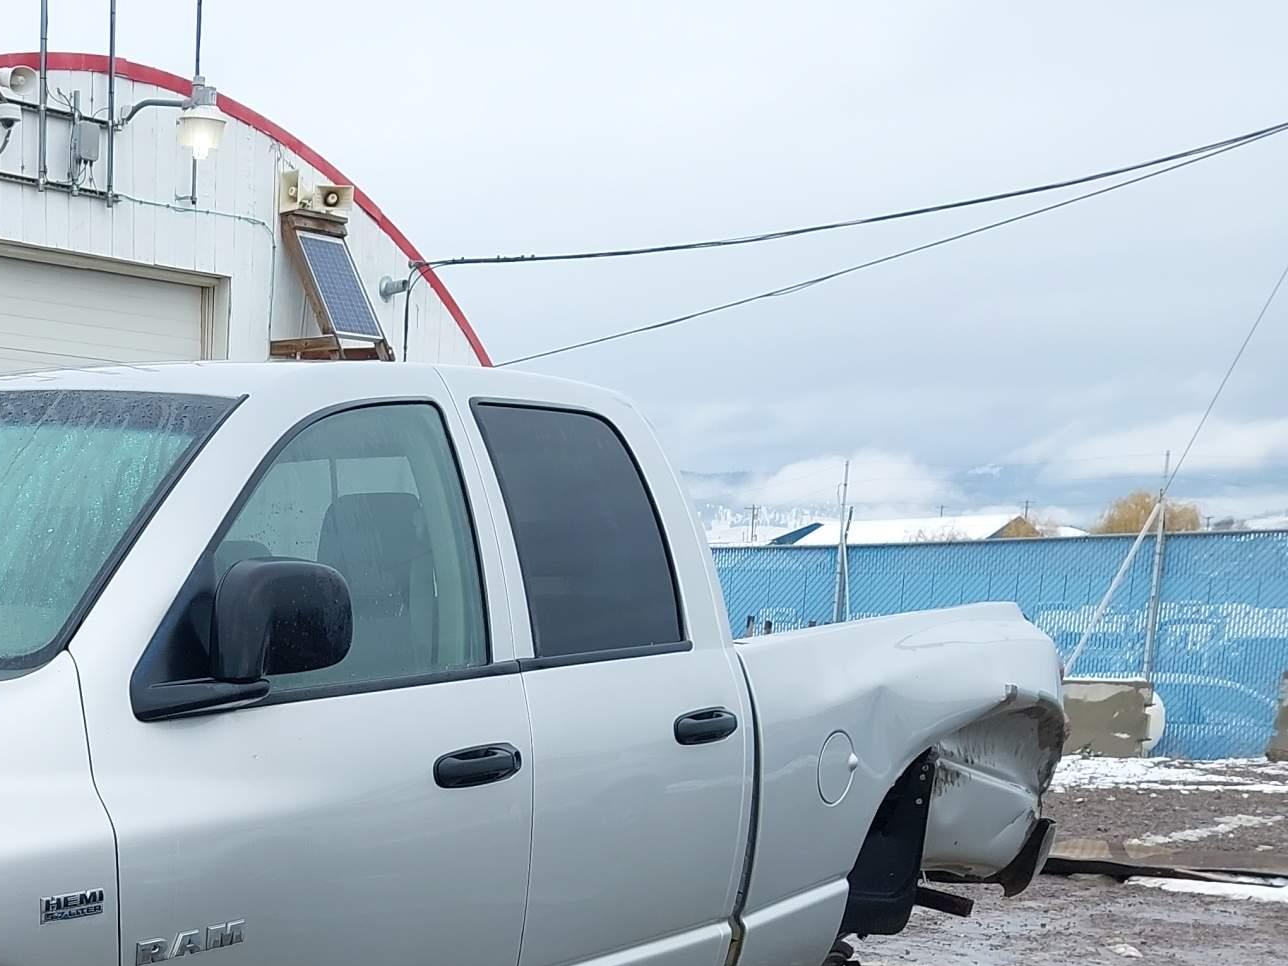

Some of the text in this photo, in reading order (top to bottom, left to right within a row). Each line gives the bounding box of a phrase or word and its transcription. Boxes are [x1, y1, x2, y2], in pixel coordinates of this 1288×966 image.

[44, 889, 104, 912] HEMI
[67, 905, 102, 918] LITER
[136, 919, 245, 966] RAM
